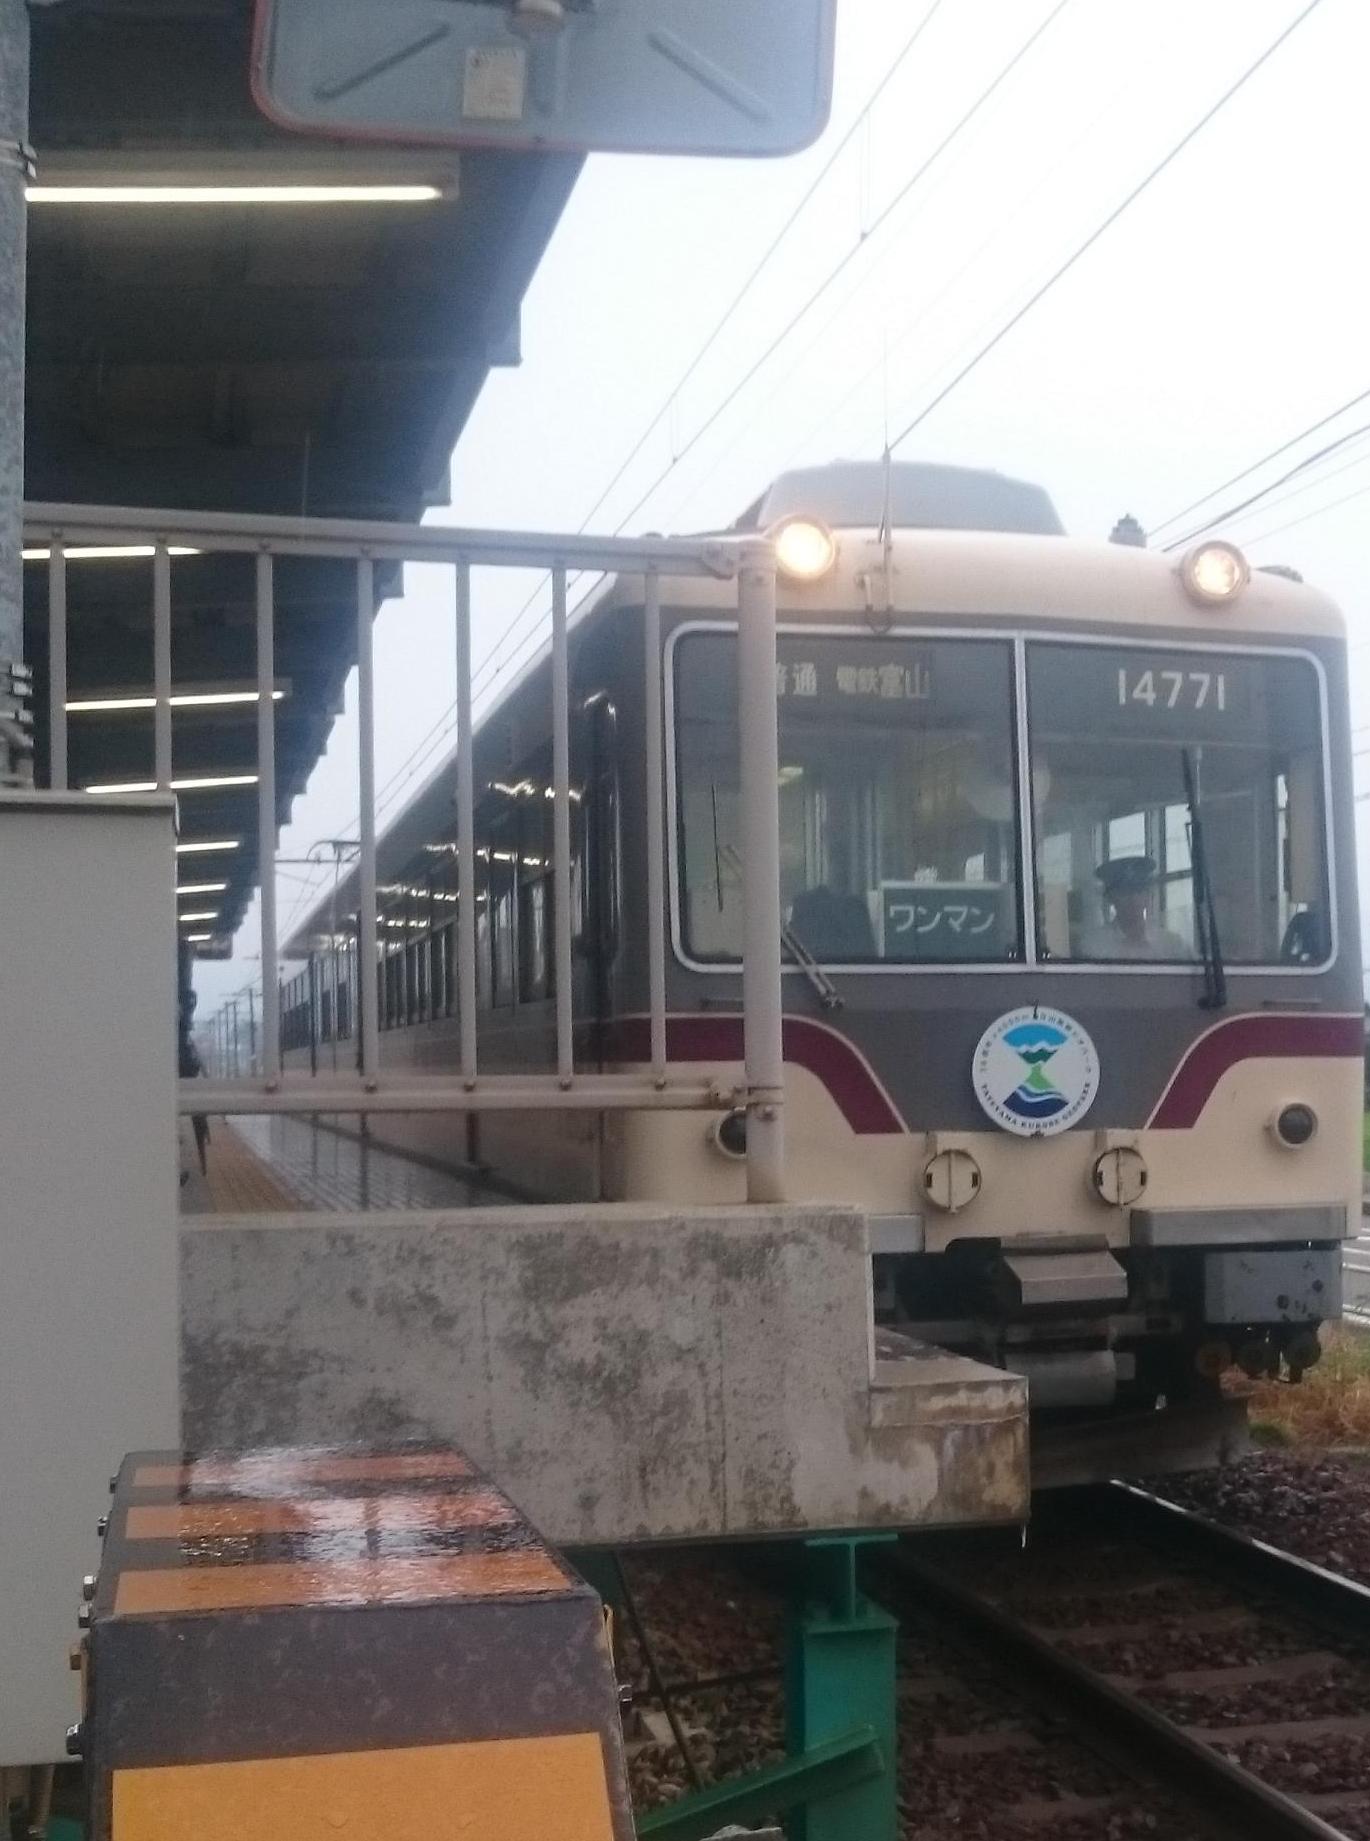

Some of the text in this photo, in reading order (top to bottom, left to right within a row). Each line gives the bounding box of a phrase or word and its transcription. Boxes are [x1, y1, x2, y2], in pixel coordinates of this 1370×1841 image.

[1119, 669, 1225, 711] 14771
[889, 905, 996, 934] ワンマン
